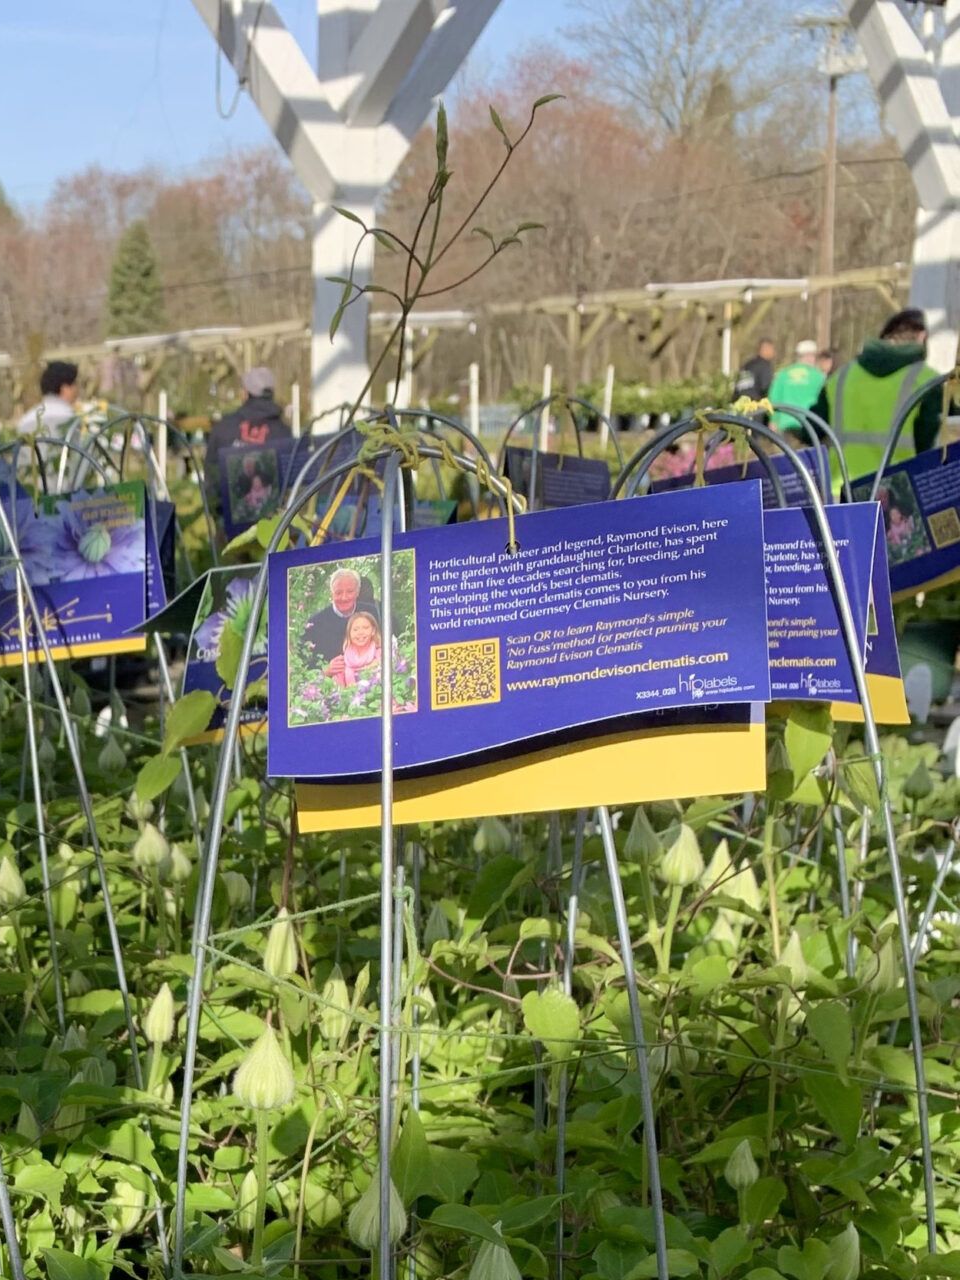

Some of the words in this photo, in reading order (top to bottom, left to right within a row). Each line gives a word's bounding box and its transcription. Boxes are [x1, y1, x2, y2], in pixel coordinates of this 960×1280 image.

[429, 552, 496, 570] Horticultural
[498, 548, 540, 564] pioneer
[541, 541, 561, 555] and
[564, 535, 605, 552] legend,
[606, 526, 659, 544] Raymond
[661, 522, 699, 536] Evison,
[703, 518, 729, 530] here
[429, 571, 440, 582] in
[442, 568, 459, 580] the
[461, 565, 499, 581] garden
[500, 561, 524, 575] with
[526, 549, 605, 572] granddaughter
[607, 539, 662, 555] Charlotte,
[664, 537, 684, 548] has
[686, 531, 718, 546] spent
[801, 551, 815, 560] has
[429, 583, 458, 594] more
[460, 579, 484, 591] than
[486, 577, 505, 588] five
[507, 570, 551, 585] decades
[553, 559, 606, 577] searching
[607, 557, 626, 568] for,
[627, 550, 681, 565] breeding,
[683, 544, 705, 557] and
[774, 562, 812, 573] breeding,
[429, 592, 489, 607] developing
[491, 588, 508, 600] the
[510, 582, 548, 597] world's
[550, 577, 573, 590] best
[574, 569, 623, 585] clematis.
[430, 607, 452, 618] This
[454, 603, 492, 617] unique
[493, 597, 537, 611] modern
[538, 586, 583, 604] clematis
[584, 583, 621, 596] comes
[623, 579, 635, 590] to
[636, 576, 658, 590] you
[660, 571, 688, 584] from
[690, 569, 707, 580] his
[768, 597, 801, 606] Nursery.
[769, 586, 777, 594] to
[778, 586, 793, 596] you
[794, 584, 814, 594] from
[815, 583, 828, 592] his
[429, 617, 461, 631] world
[463, 611, 518, 627] renowned
[519, 602, 572, 619] Guernsey
[573, 593, 621, 610] Clematis
[623, 588, 670, 601] Nursery.
[506, 634, 531, 646] Scan
[533, 630, 552, 641] QR
[553, 628, 565, 638] to
[566, 624, 593, 637] learn
[595, 613, 655, 631] Raymond's
[657, 607, 695, 622] simple
[790, 616, 817, 628] simple
[597, 632, 613, 643] for
[614, 626, 653, 643] perfect
[654, 621, 700, 638] pruning
[701, 617, 728, 631] your
[787, 628, 819, 639] pruning
[820, 628, 839, 638] your
[506, 653, 557, 671] Raymond
[559, 649, 593, 662] Evison
[595, 640, 643, 656] Clematis
[506, 651, 729, 692] www.raymondevisonclematis.com
